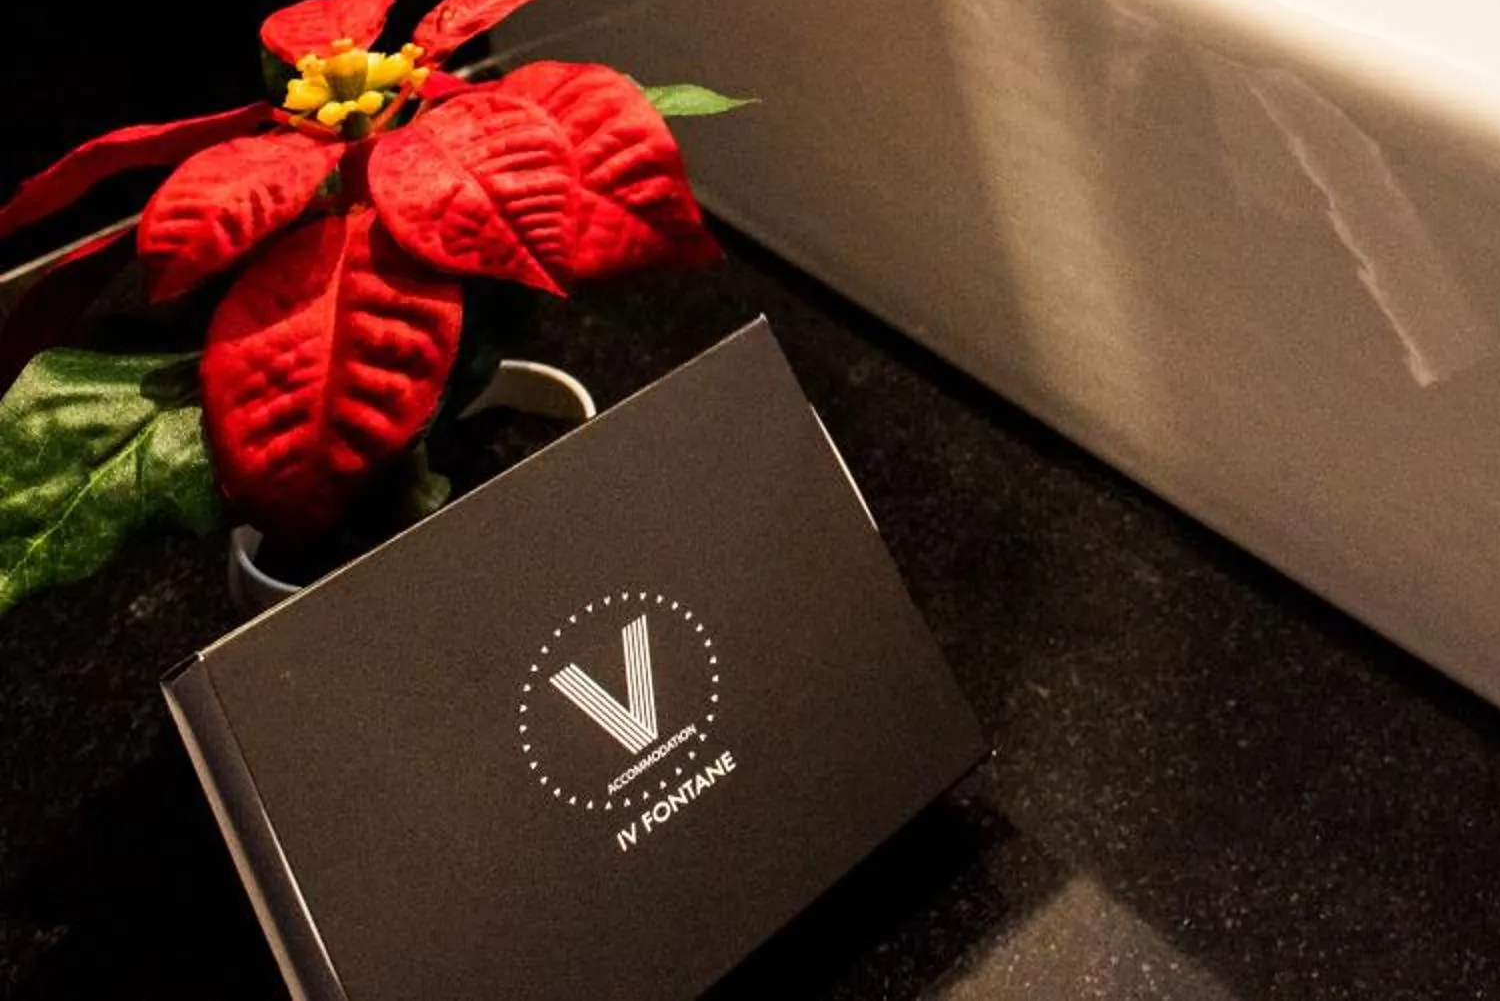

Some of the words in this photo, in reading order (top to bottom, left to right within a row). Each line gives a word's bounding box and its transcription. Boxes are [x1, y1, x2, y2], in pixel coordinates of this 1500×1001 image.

[607, 724, 697, 795] ACCOMMODATION
[616, 822, 638, 852] IV
[641, 750, 737, 832] FONTANE
